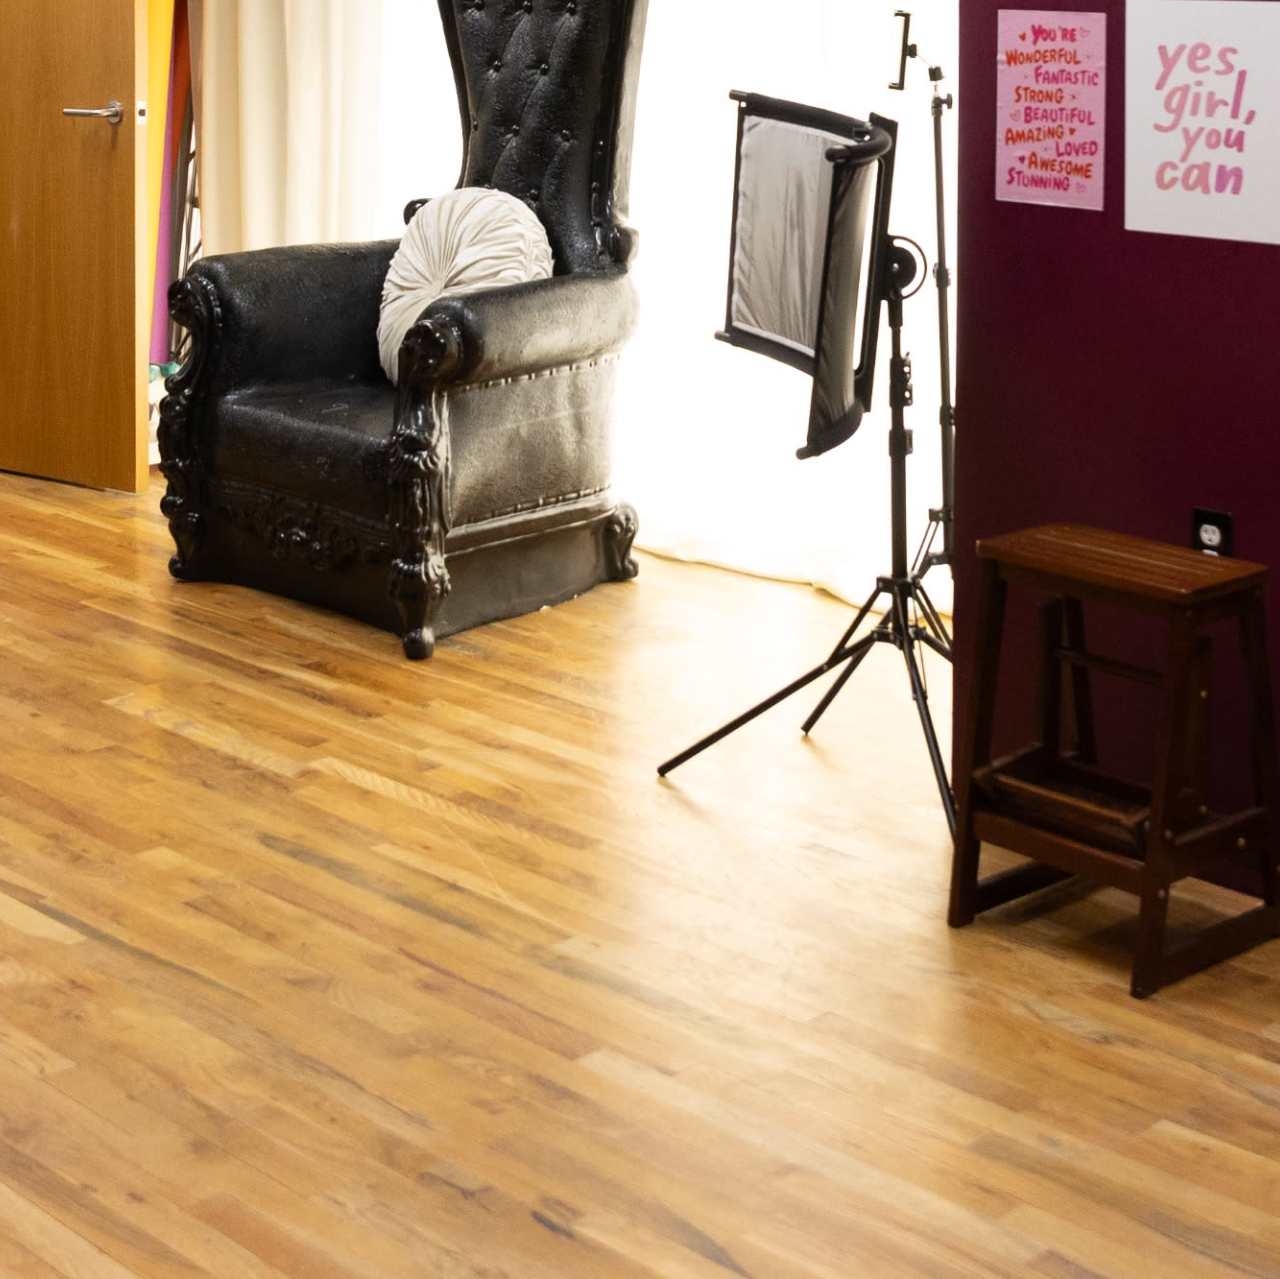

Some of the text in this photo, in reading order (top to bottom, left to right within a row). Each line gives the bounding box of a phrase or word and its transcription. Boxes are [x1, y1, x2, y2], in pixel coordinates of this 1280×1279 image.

[1005, 48, 1081, 66] WONDERFUL
[1155, 41, 1239, 91] yes
[1034, 66, 1099, 86] FANTASTIC
[1015, 86, 1064, 104] STRONG
[1153, 69, 1256, 133] girl,
[1023, 106, 1095, 125] BEAUTIFUL
[1005, 124, 1064, 145] AMAZING
[1178, 126, 1245, 163] you
[1055, 140, 1098, 157] LOVED
[1028, 152, 1093, 178] AWESOME
[1006, 167, 1070, 191] STUNNING
[1154, 161, 1244, 195] can
